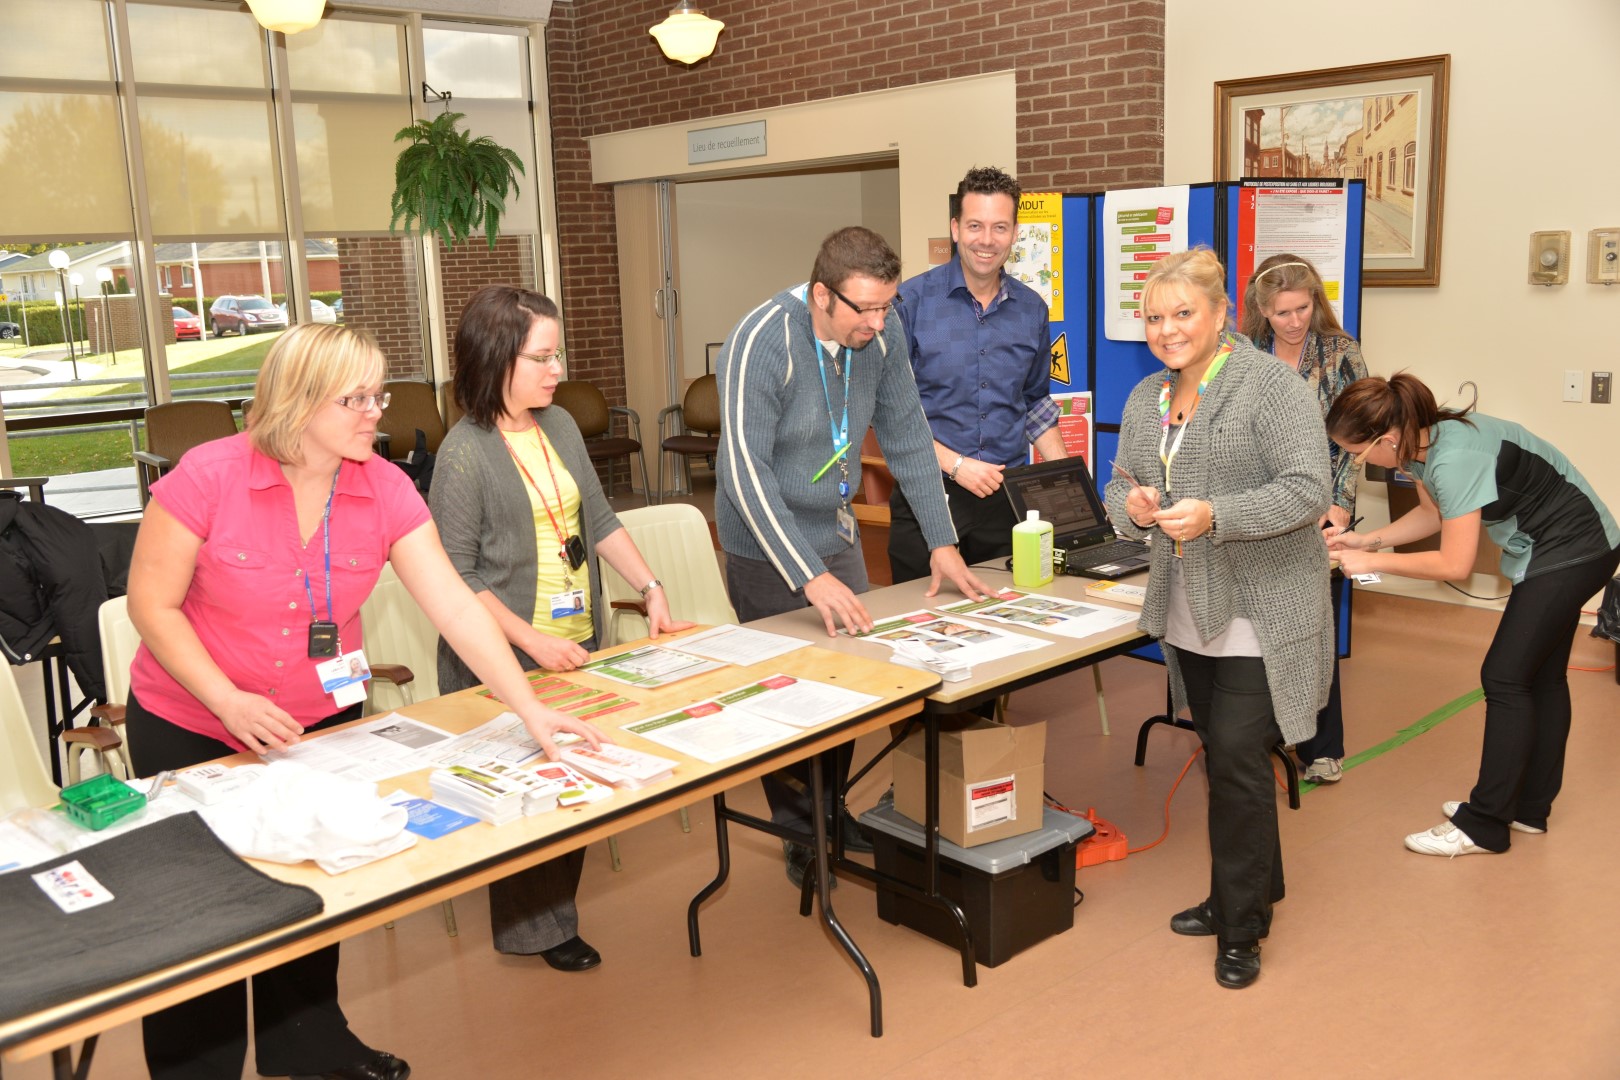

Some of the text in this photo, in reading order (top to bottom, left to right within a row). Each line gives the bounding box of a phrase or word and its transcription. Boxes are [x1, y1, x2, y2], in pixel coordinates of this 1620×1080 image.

[692, 136, 760, 153] Lieu de recueillement
[934, 246, 949, 254] Place
